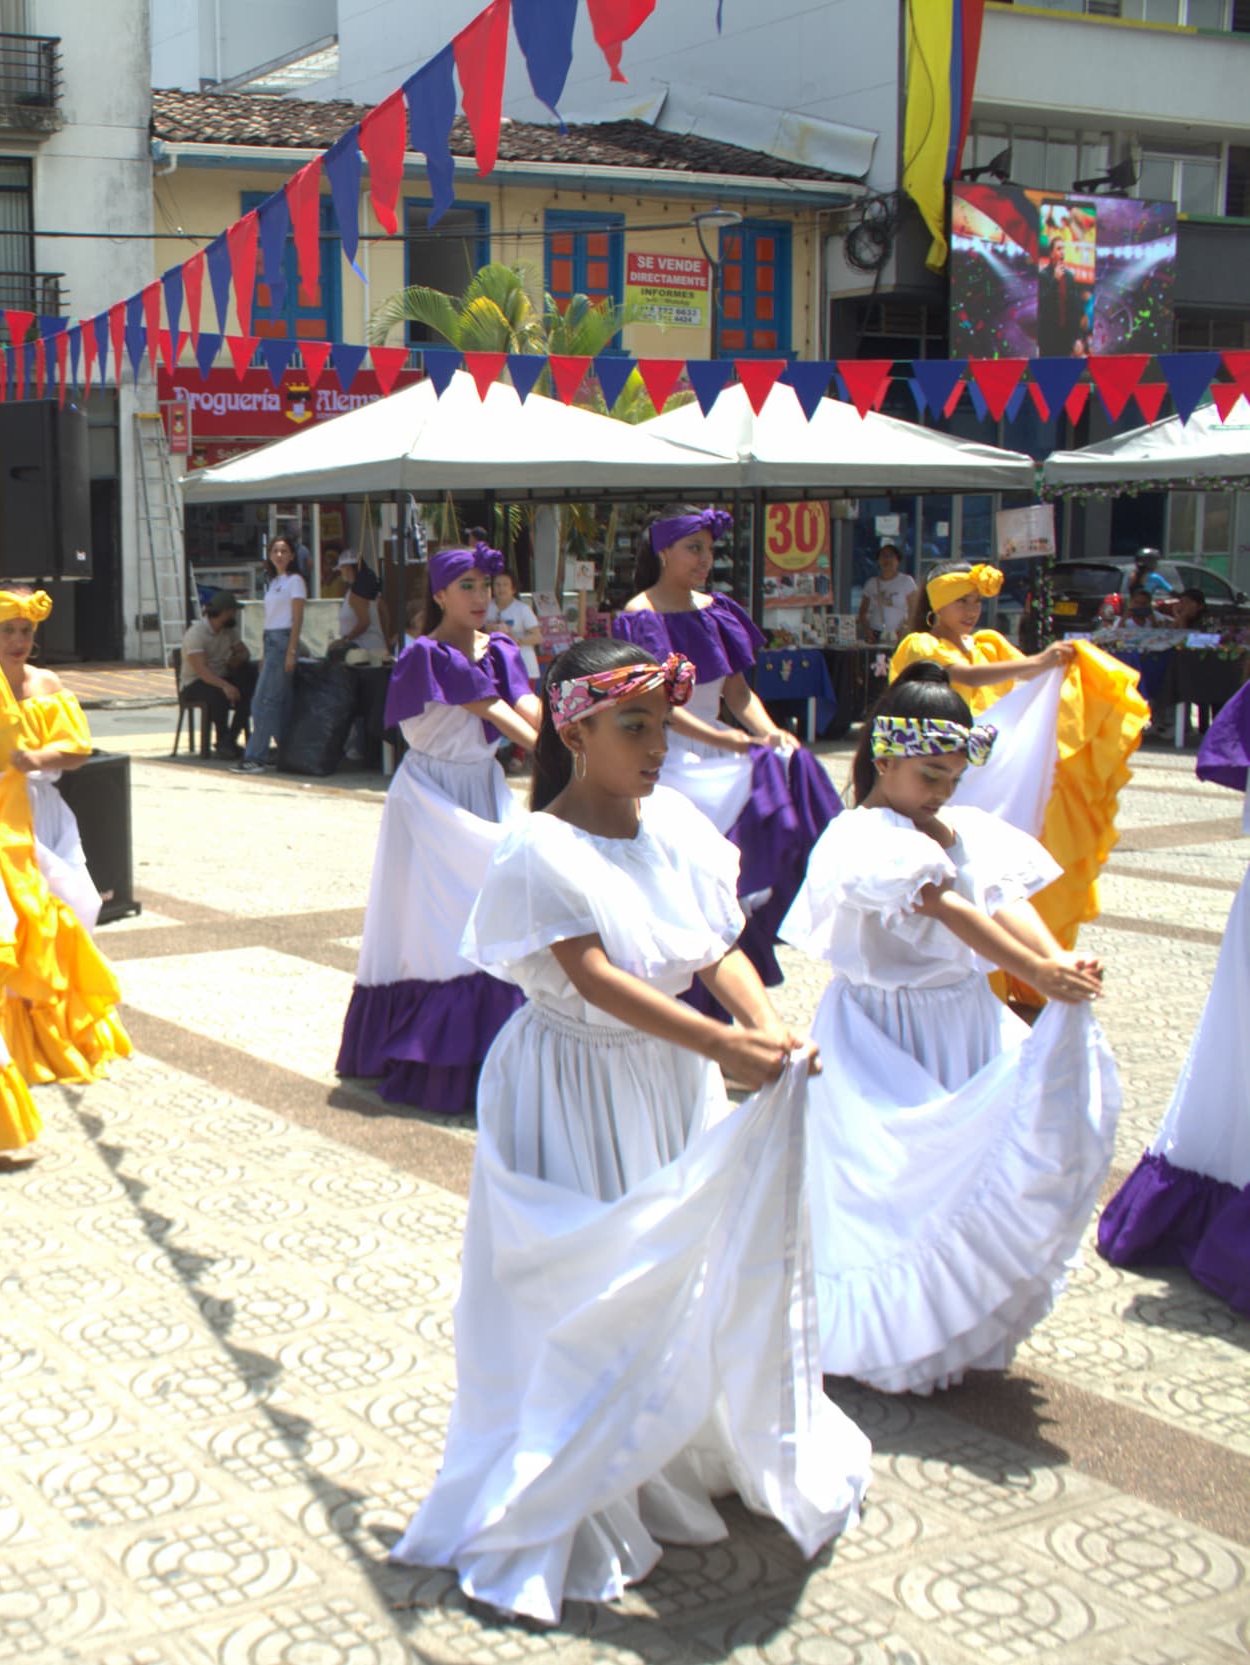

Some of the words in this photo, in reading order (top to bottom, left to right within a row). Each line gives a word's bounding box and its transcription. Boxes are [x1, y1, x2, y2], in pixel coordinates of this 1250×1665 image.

[637, 255, 655, 269] SE
[657, 257, 702, 273] VENDE
[630, 271, 707, 287] DIRECTAMENTE
[640, 288, 695, 299] INFORMES
[173, 386, 281, 416] Droguería
